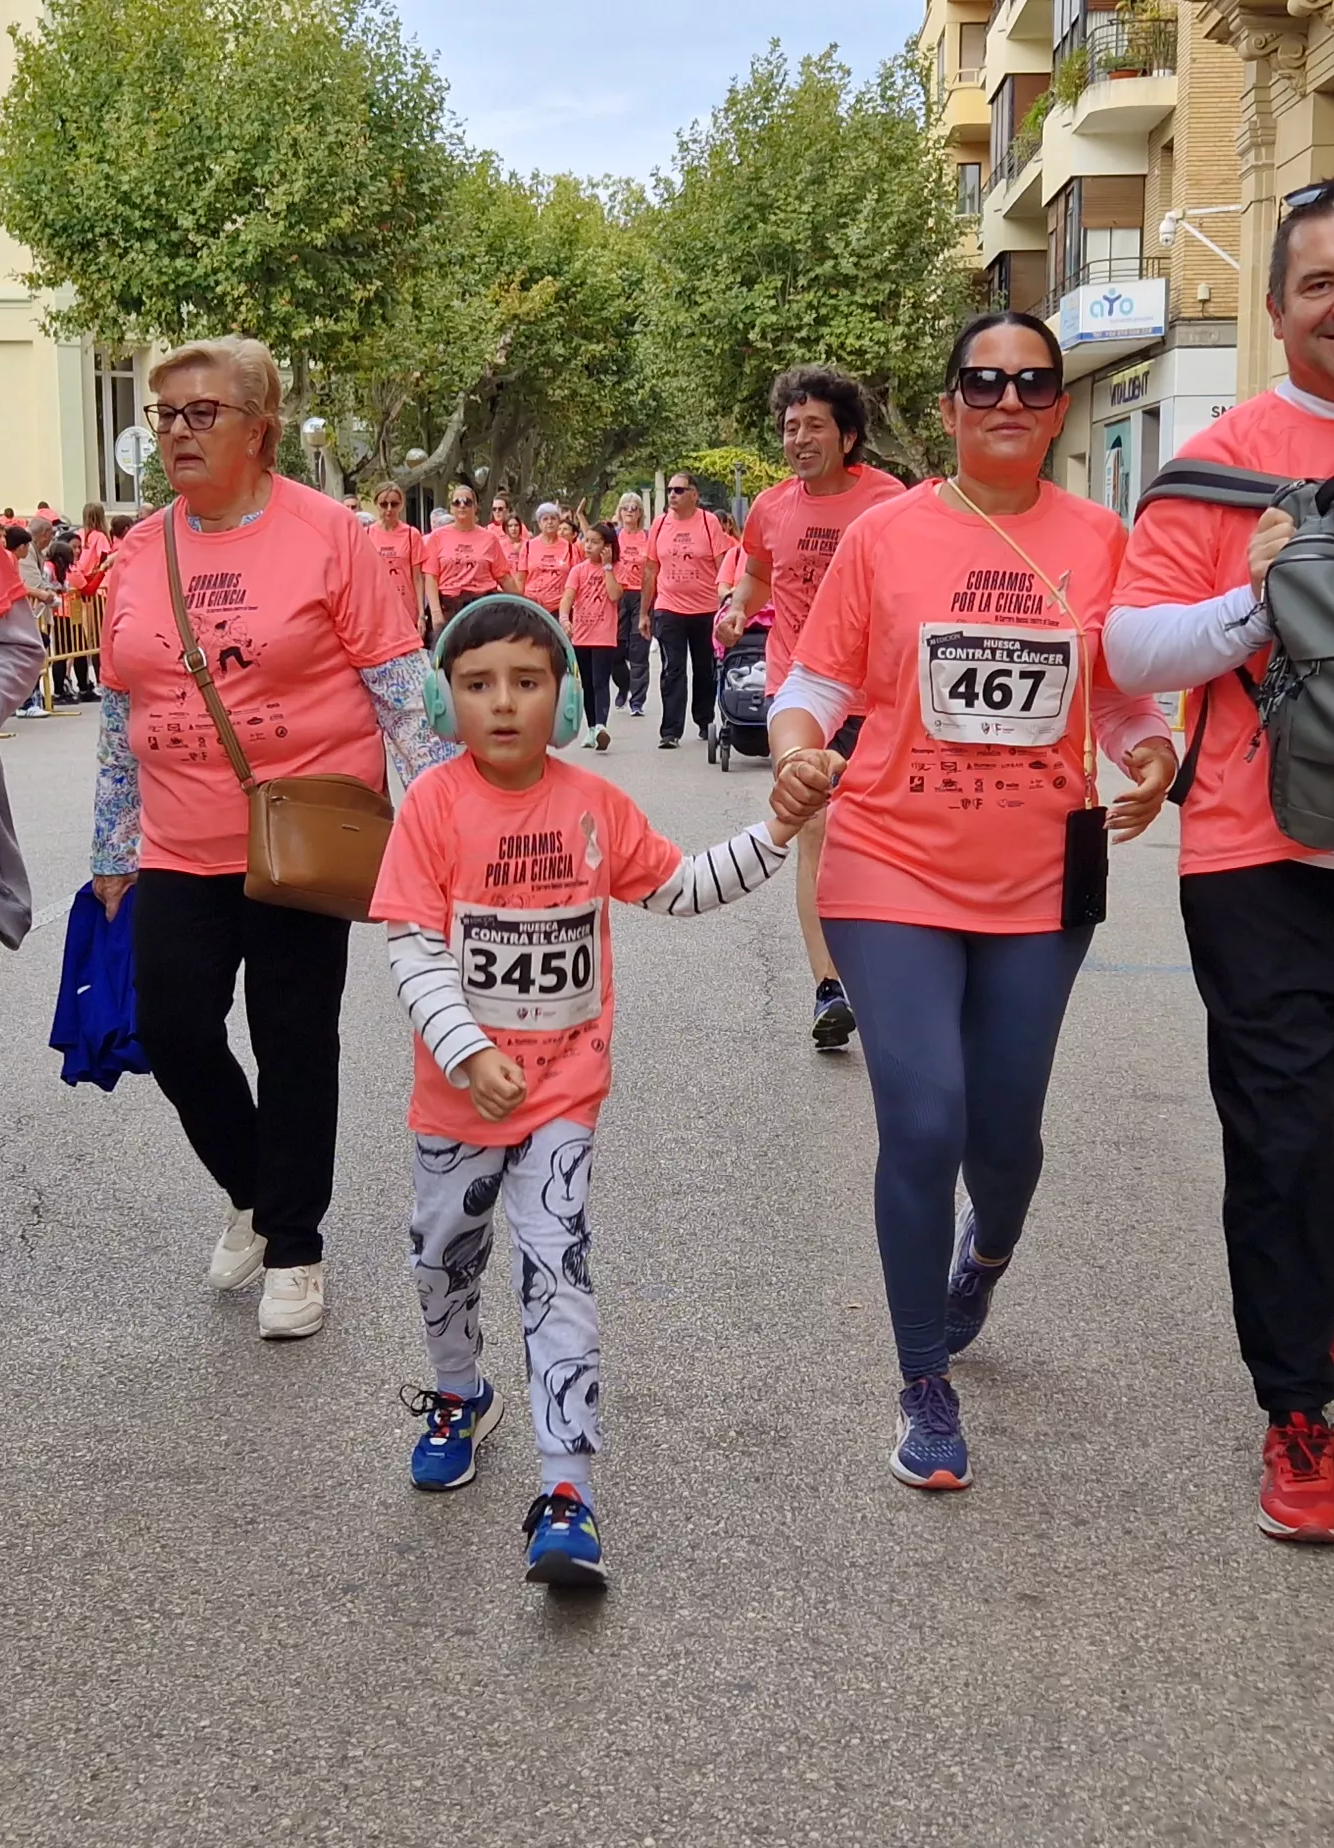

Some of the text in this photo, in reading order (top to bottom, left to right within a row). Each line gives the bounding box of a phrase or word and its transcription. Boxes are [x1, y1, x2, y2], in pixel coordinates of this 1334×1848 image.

[188, 572, 242, 593] CORRAMOS
[967, 570, 1034, 592] CORRAMOS
[207, 589, 247, 607] CIENCIA
[951, 591, 1044, 615] POR LA CIENCIA
[983, 639, 1021, 650] HUESCA
[937, 647, 1064, 665] CONTRA EL CÁNCER
[948, 667, 1047, 712] 467
[499, 830, 563, 860] CORRAMOS
[485, 861, 510, 888] POR
[513, 859, 526, 884] LA
[531, 853, 574, 882] CIENCIA
[471, 923, 592, 945] CONTRA EL CÁNCER
[519, 922, 558, 933] HUESCA
[467, 944, 592, 995] 3450
